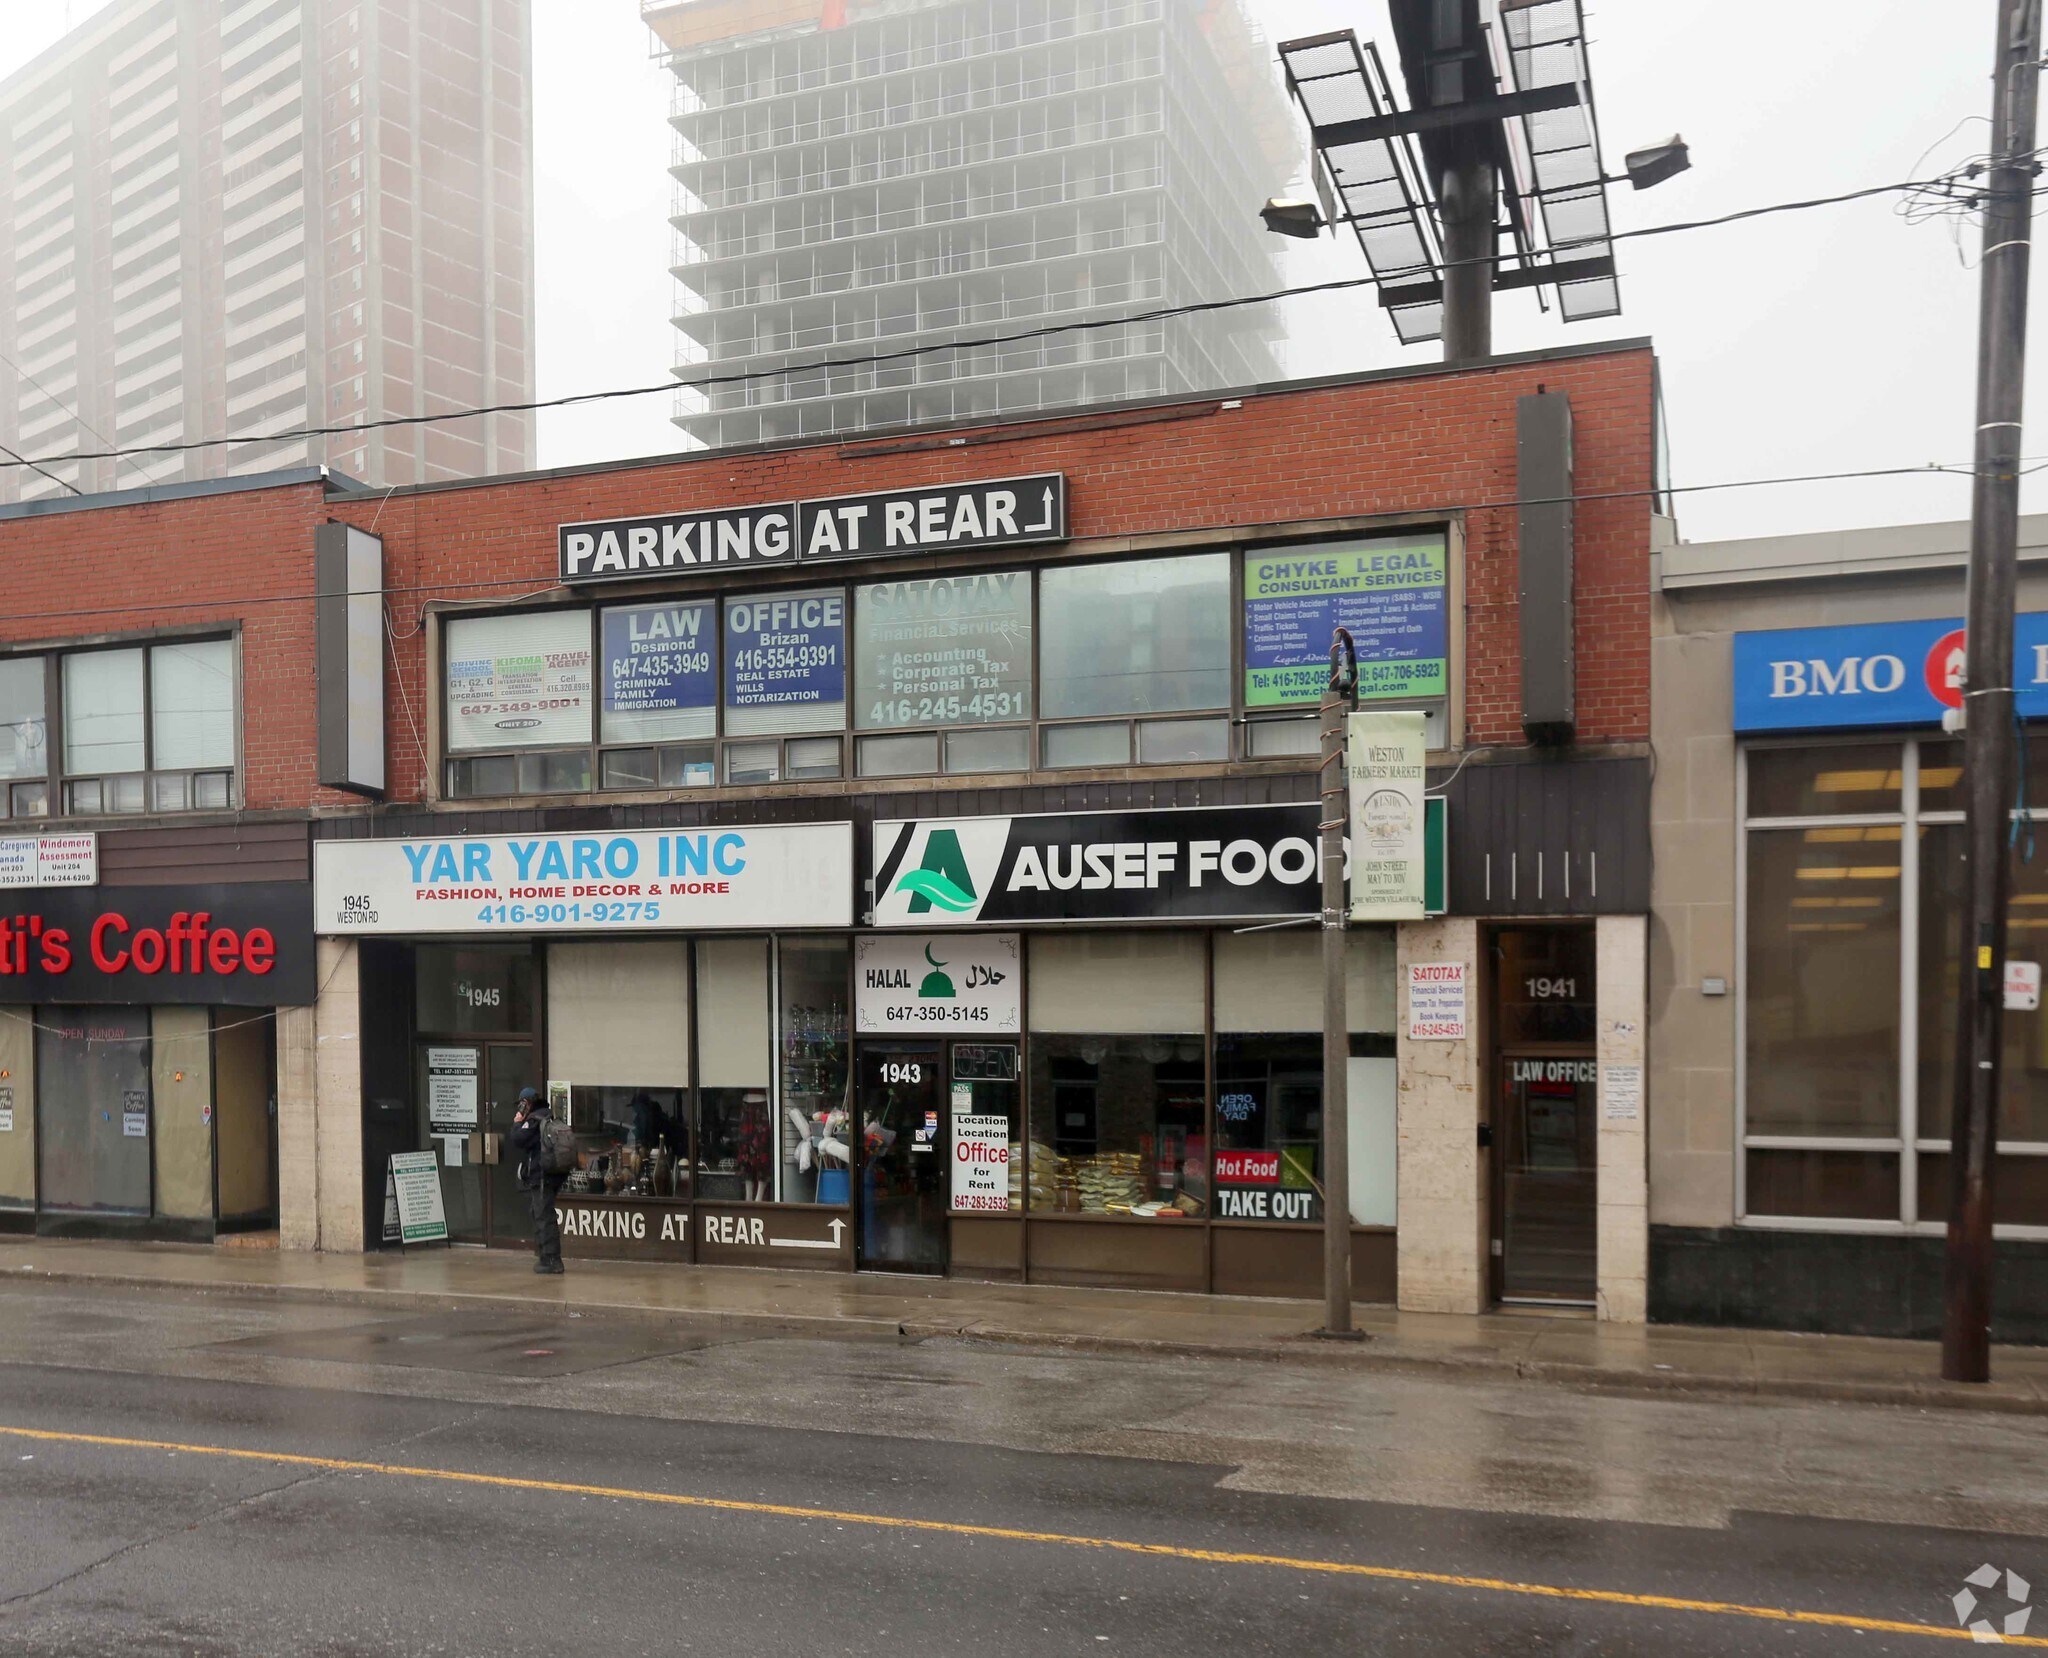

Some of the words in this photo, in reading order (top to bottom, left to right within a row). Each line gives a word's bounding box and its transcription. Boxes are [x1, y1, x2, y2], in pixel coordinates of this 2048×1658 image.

[566, 513, 790, 574] PARKING
[808, 506, 868, 554] AT
[884, 490, 1018, 547] REAR
[1258, 559, 1338, 580] CHYKE
[1357, 552, 1433, 573] LEGAL
[1258, 576, 1360, 594] CONSULTANT
[1365, 570, 1443, 587] SERVICES
[870, 574, 1017, 618] SATOTAX
[1274, 601, 1299, 609] Vehicle
[1299, 599, 1329, 607] Accident
[730, 598, 842, 633] OFFICE
[1254, 613, 1273, 622] Small
[1274, 612, 1297, 620] Claims
[1297, 610, 1320, 619] Courts
[629, 608, 702, 641] LAW
[871, 622, 948, 642] Financial
[949, 617, 1020, 637] Services
[1253, 623, 1275, 632] Traffic
[1275, 622, 1299, 631] Tickets
[631, 638, 696, 655] Desmond
[760, 633, 809, 646] Brizan
[544, 651, 591, 662] TRAVEL
[735, 645, 836, 670] 416-554-9391
[892, 647, 987, 665] Accounting
[1273, 655, 1301, 666] Legal
[548, 659, 588, 669] AGENT
[612, 652, 709, 678] 647-435-3949
[892, 661, 976, 681] Corporate
[982, 660, 1010, 674] Tax
[560, 675, 576, 683] Cell
[736, 671, 765, 681] REAL
[768, 668, 811, 680] ESTATE
[1252, 674, 1270, 689] Tel:
[1372, 662, 1440, 682] 647-706-5923
[1769, 654, 1906, 698] BMO
[450, 680, 466, 688] G1,
[468, 679, 484, 688] G2,
[486, 678, 494, 686] G
[614, 677, 671, 689] CRIMINAL
[735, 682, 765, 693] WILLS
[892, 677, 965, 694] Personal
[971, 675, 999, 689] Tax
[450, 691, 495, 700] UPGRADING
[614, 689, 657, 700] FAMILY
[736, 690, 819, 704] NOTARIZATION
[460, 697, 580, 716] 647-349-9001
[614, 698, 677, 711] IMMIGRATION
[870, 691, 1023, 722] 416-245-4531
[1368, 745, 1405, 762] WESTON
[1389, 765, 1422, 779] MARKET
[0, 841, 36, 853] Caregivers
[40, 839, 92, 849] Windemere
[40, 851, 92, 861] Assessment
[402, 843, 492, 883] YAR
[507, 837, 639, 881] YARO
[658, 833, 746, 877] INC
[1006, 842, 1178, 892] AUSEF
[1365, 861, 1383, 872] JOHN
[1383, 860, 1408, 872] STREET
[43, 874, 91, 882] 416-244-6200
[1367, 872, 1383, 884] MAY
[1383, 872, 1393, 884] TO
[1393, 872, 1407, 884] NOV
[415, 885, 503, 902] FASHION,
[509, 885, 567, 899] HOME
[572, 883, 641, 898] DECOR
[648, 883, 663, 896] &
[669, 882, 730, 895] MORE
[343, 895, 371, 911] 1945
[336, 911, 367, 924] WESTON
[368, 911, 379, 923] RD
[477, 901, 660, 924] 416-901-9275
[0, 914, 73, 974] ti's
[91, 911, 277, 974] Coffee
[866, 969, 912, 988] HALAL
[965, 964, 1007, 989] حلال
[1413, 966, 1463, 981] SATOTAX
[1412, 985, 1438, 994] Financial
[1438, 985, 1464, 994] Services
[1525, 977, 1577, 997] 1941
[467, 988, 500, 1006] 1945
[886, 1006, 989, 1021] 647-350-5145
[1420, 1012, 1434, 1020] Book
[1435, 1012, 1458, 1022] Keeping
[58, 1028, 84, 1040] OPEN
[88, 1027, 126, 1040] SUNDAY
[1412, 1023, 1464, 1036] 416-245-4531
[957, 1048, 1013, 1078] OPEN
[880, 1063, 921, 1084] 1943
[1513, 1061, 1543, 1081] LAW
[1546, 1061, 1597, 1082] OFFICE
[953, 1085, 970, 1094] PASS
[958, 1116, 1007, 1126] Location
[958, 1128, 1007, 1138] Location
[956, 1141, 1008, 1163] Office
[973, 1167, 990, 1177] for
[1216, 1157, 1241, 1176] Hot
[1243, 1158, 1278, 1177] Food
[968, 1180, 995, 1190] Rent
[954, 1195, 1008, 1210] 647-283-2532
[1218, 1190, 1268, 1218] TAKE
[1272, 1192, 1312, 1219] OUT
[660, 1214, 688, 1241] AT
[705, 1215, 766, 1246] REAR
